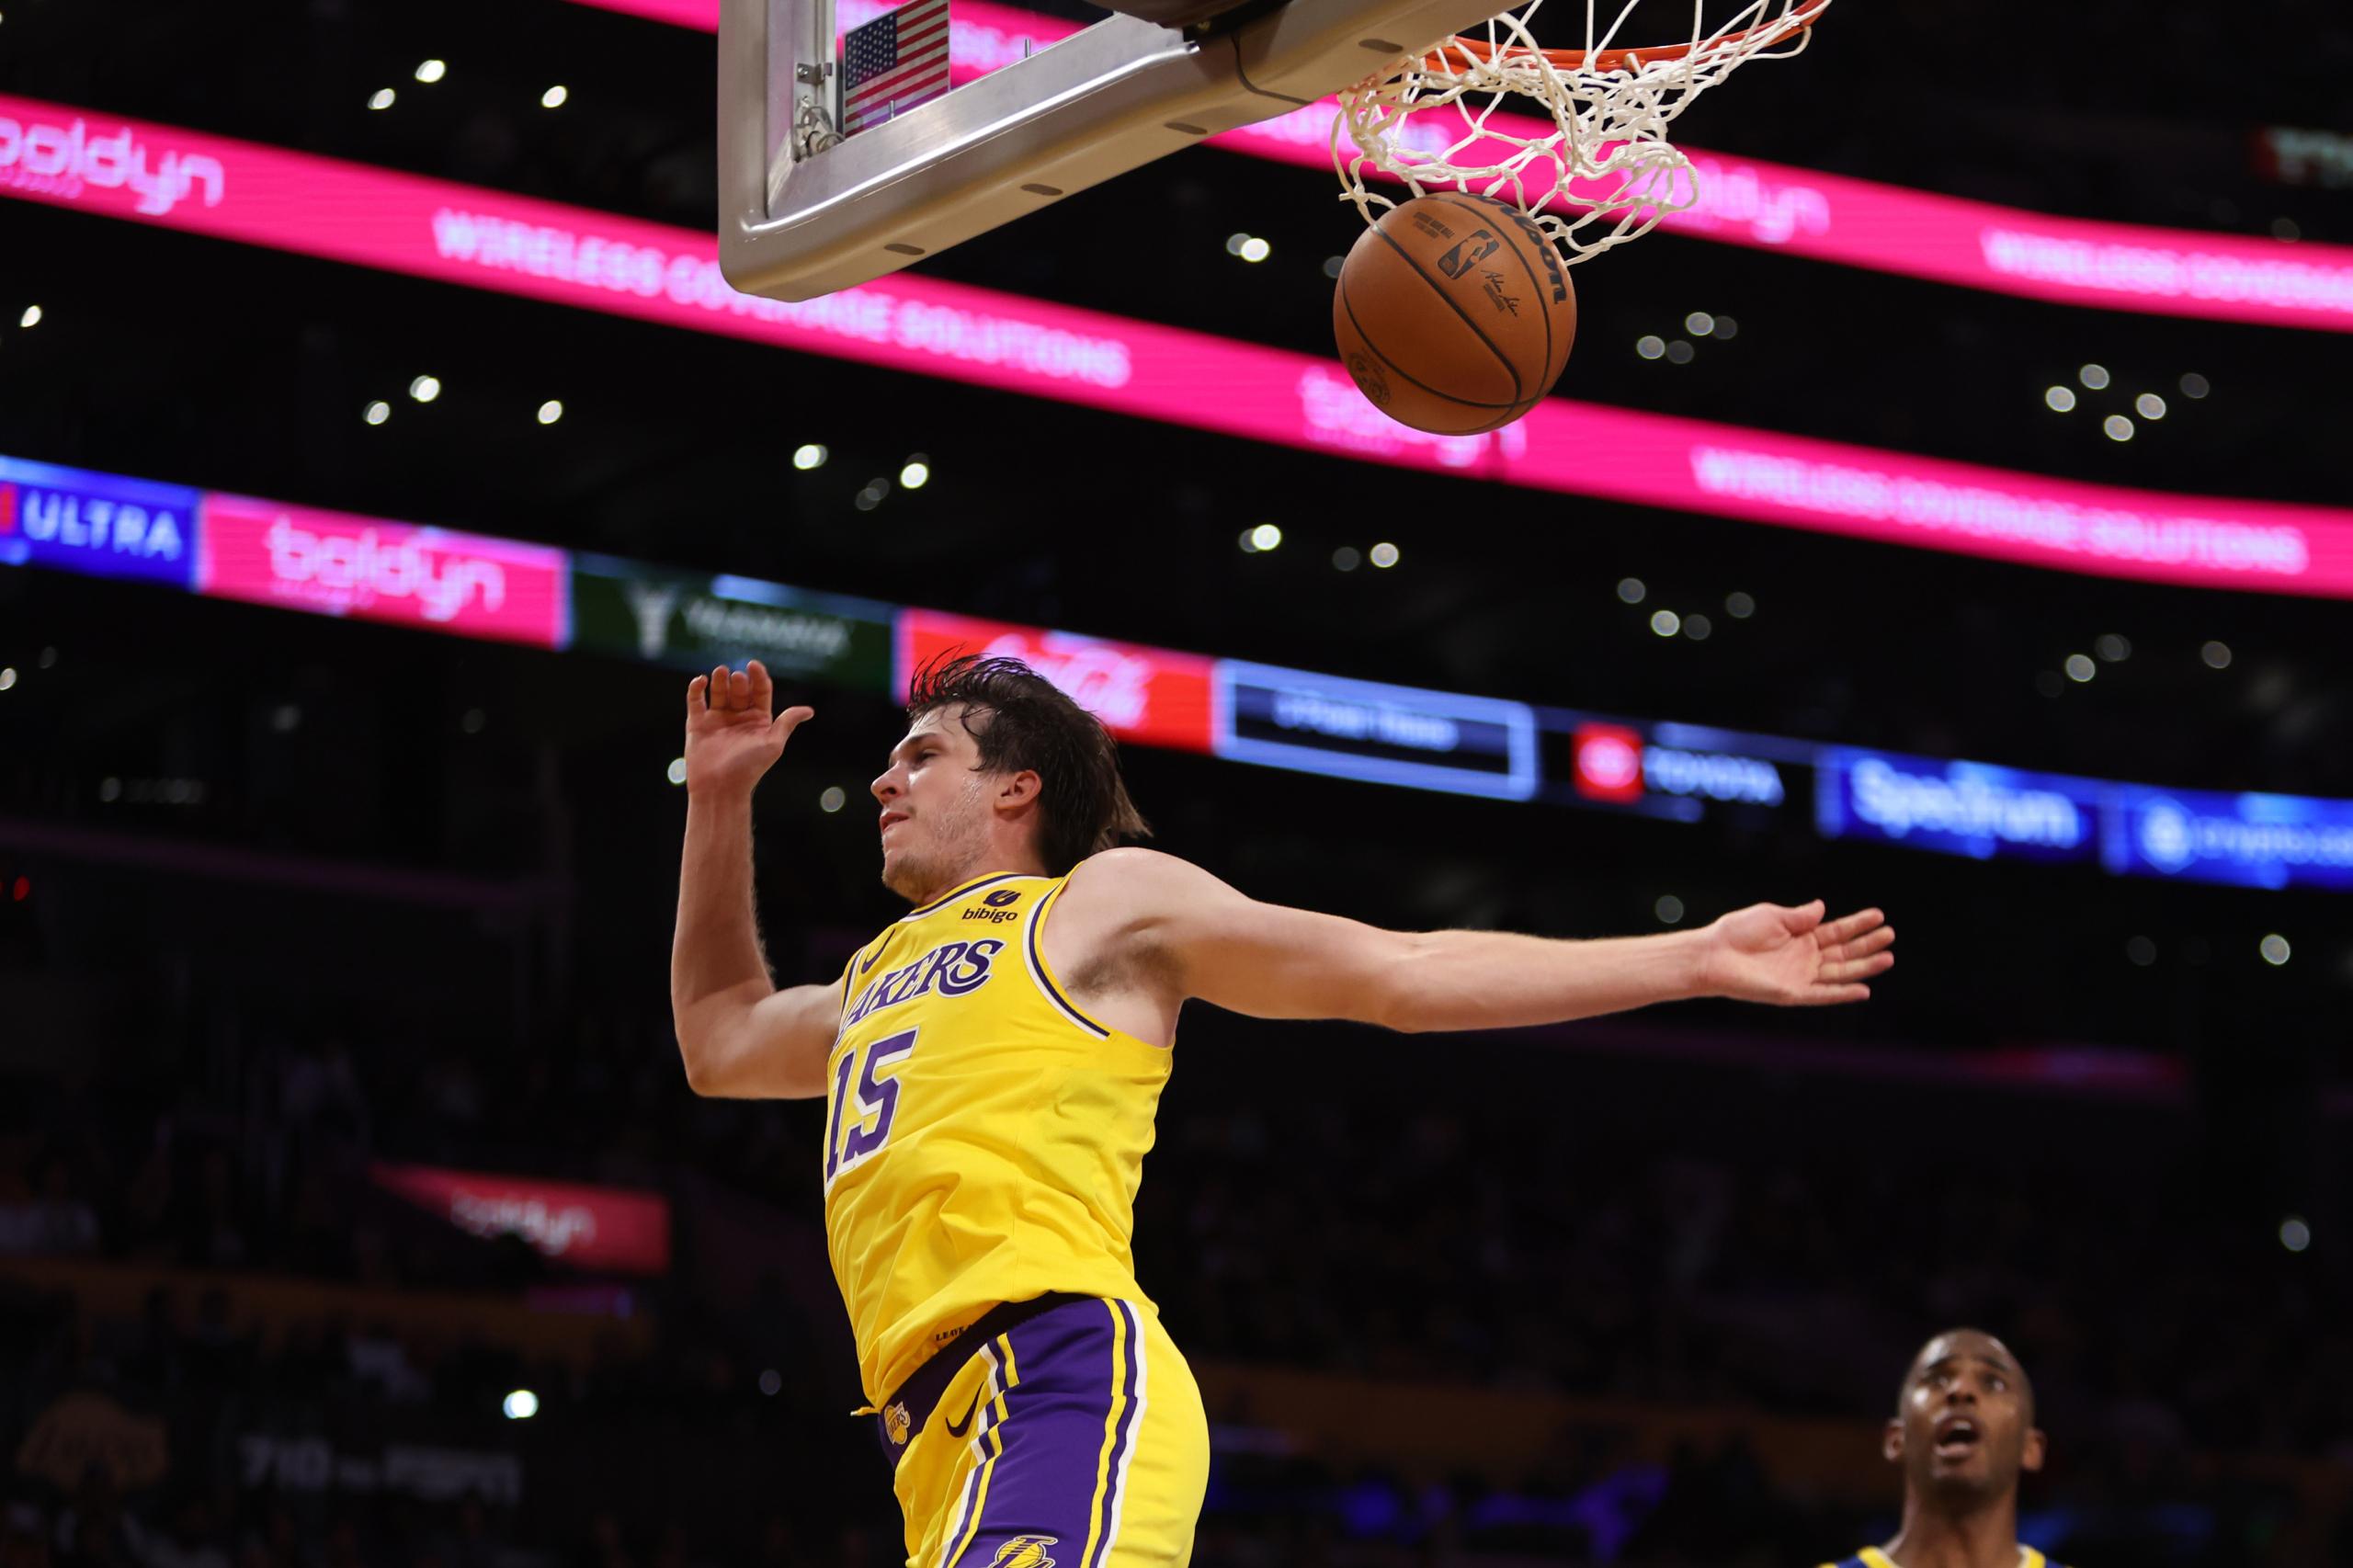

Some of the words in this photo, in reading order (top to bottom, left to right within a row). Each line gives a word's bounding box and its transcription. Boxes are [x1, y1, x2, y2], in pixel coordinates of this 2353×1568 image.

[22, 488, 183, 562] ULTRA
[962, 907, 1018, 924] bibigo
[824, 1026, 920, 1193] 15
